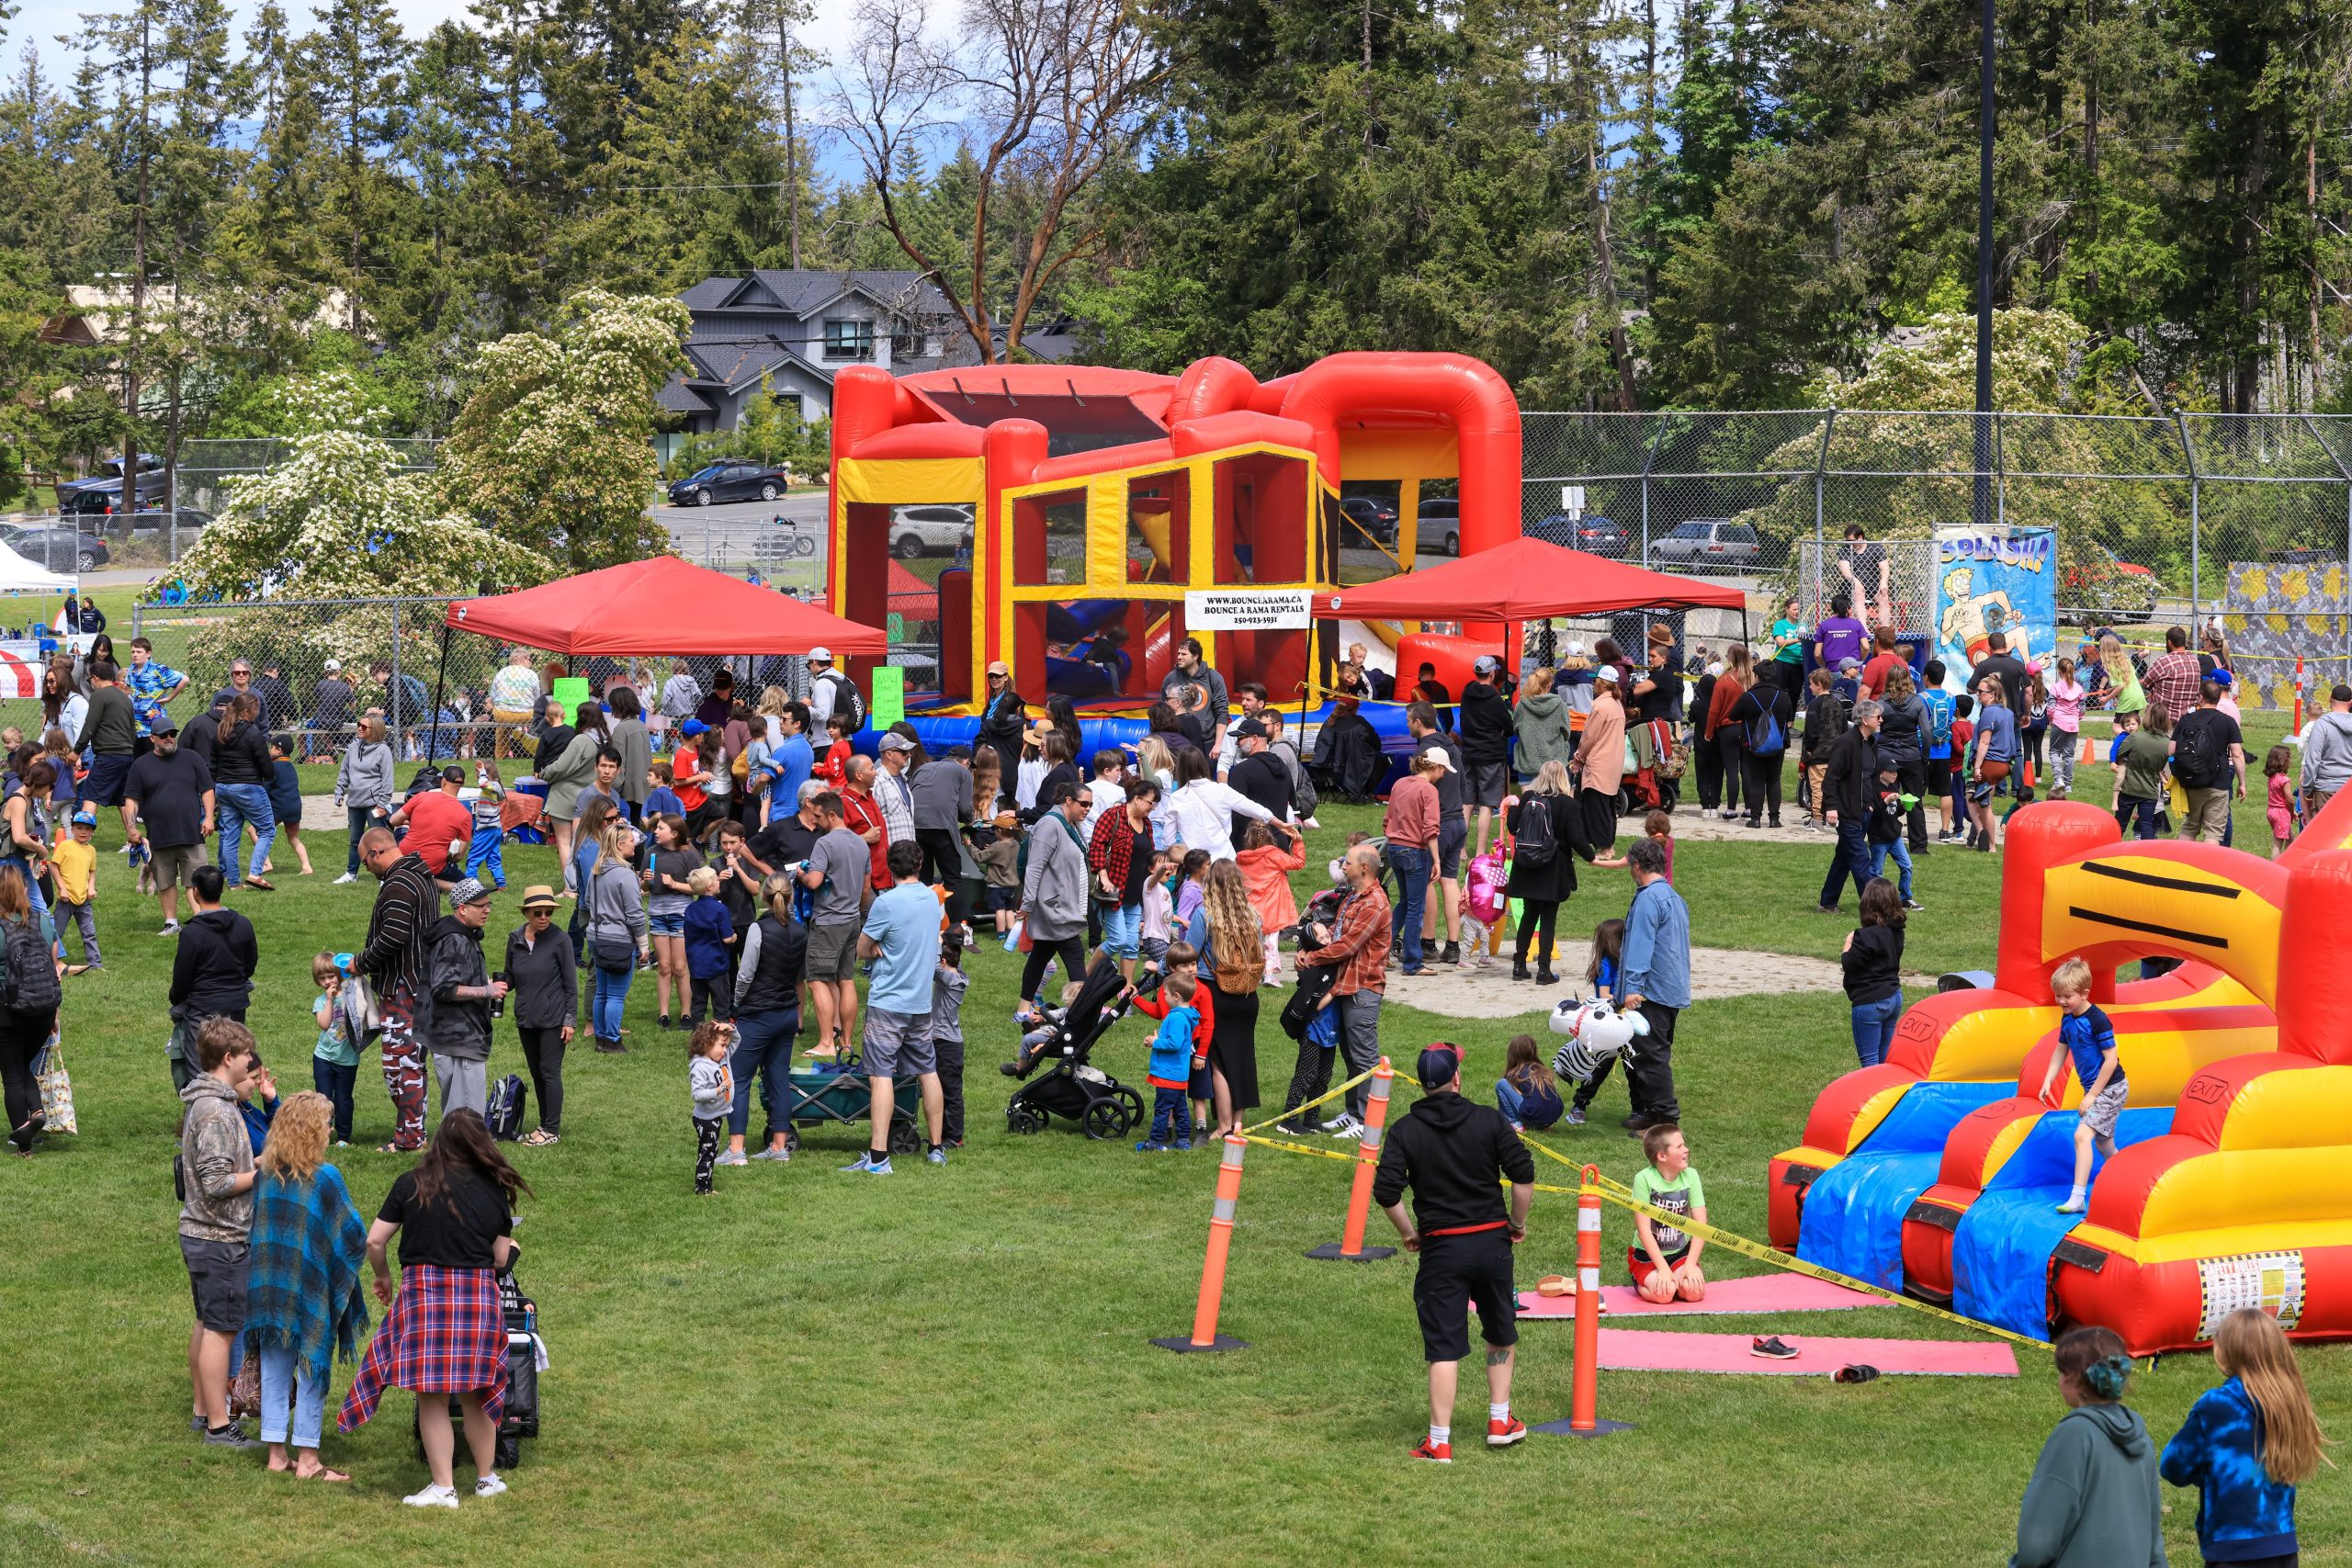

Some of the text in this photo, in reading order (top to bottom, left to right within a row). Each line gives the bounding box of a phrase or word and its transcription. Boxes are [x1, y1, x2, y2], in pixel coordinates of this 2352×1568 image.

[1940, 536, 2050, 574] SPLASH!
[1206, 596, 1302, 604] WWW.BOUNCEARAMA.CA
[1204, 606, 1238, 615] BOUNCE
[1903, 1018, 1930, 1037] EXIT
[2190, 1080, 2224, 1099] EXIT
[1657, 1198, 1687, 1214] HERE
[1657, 1227, 1679, 1242] WIN
[2204, 1262, 2233, 1276] SAFETY
[2233, 1259, 2259, 1273] RULES
